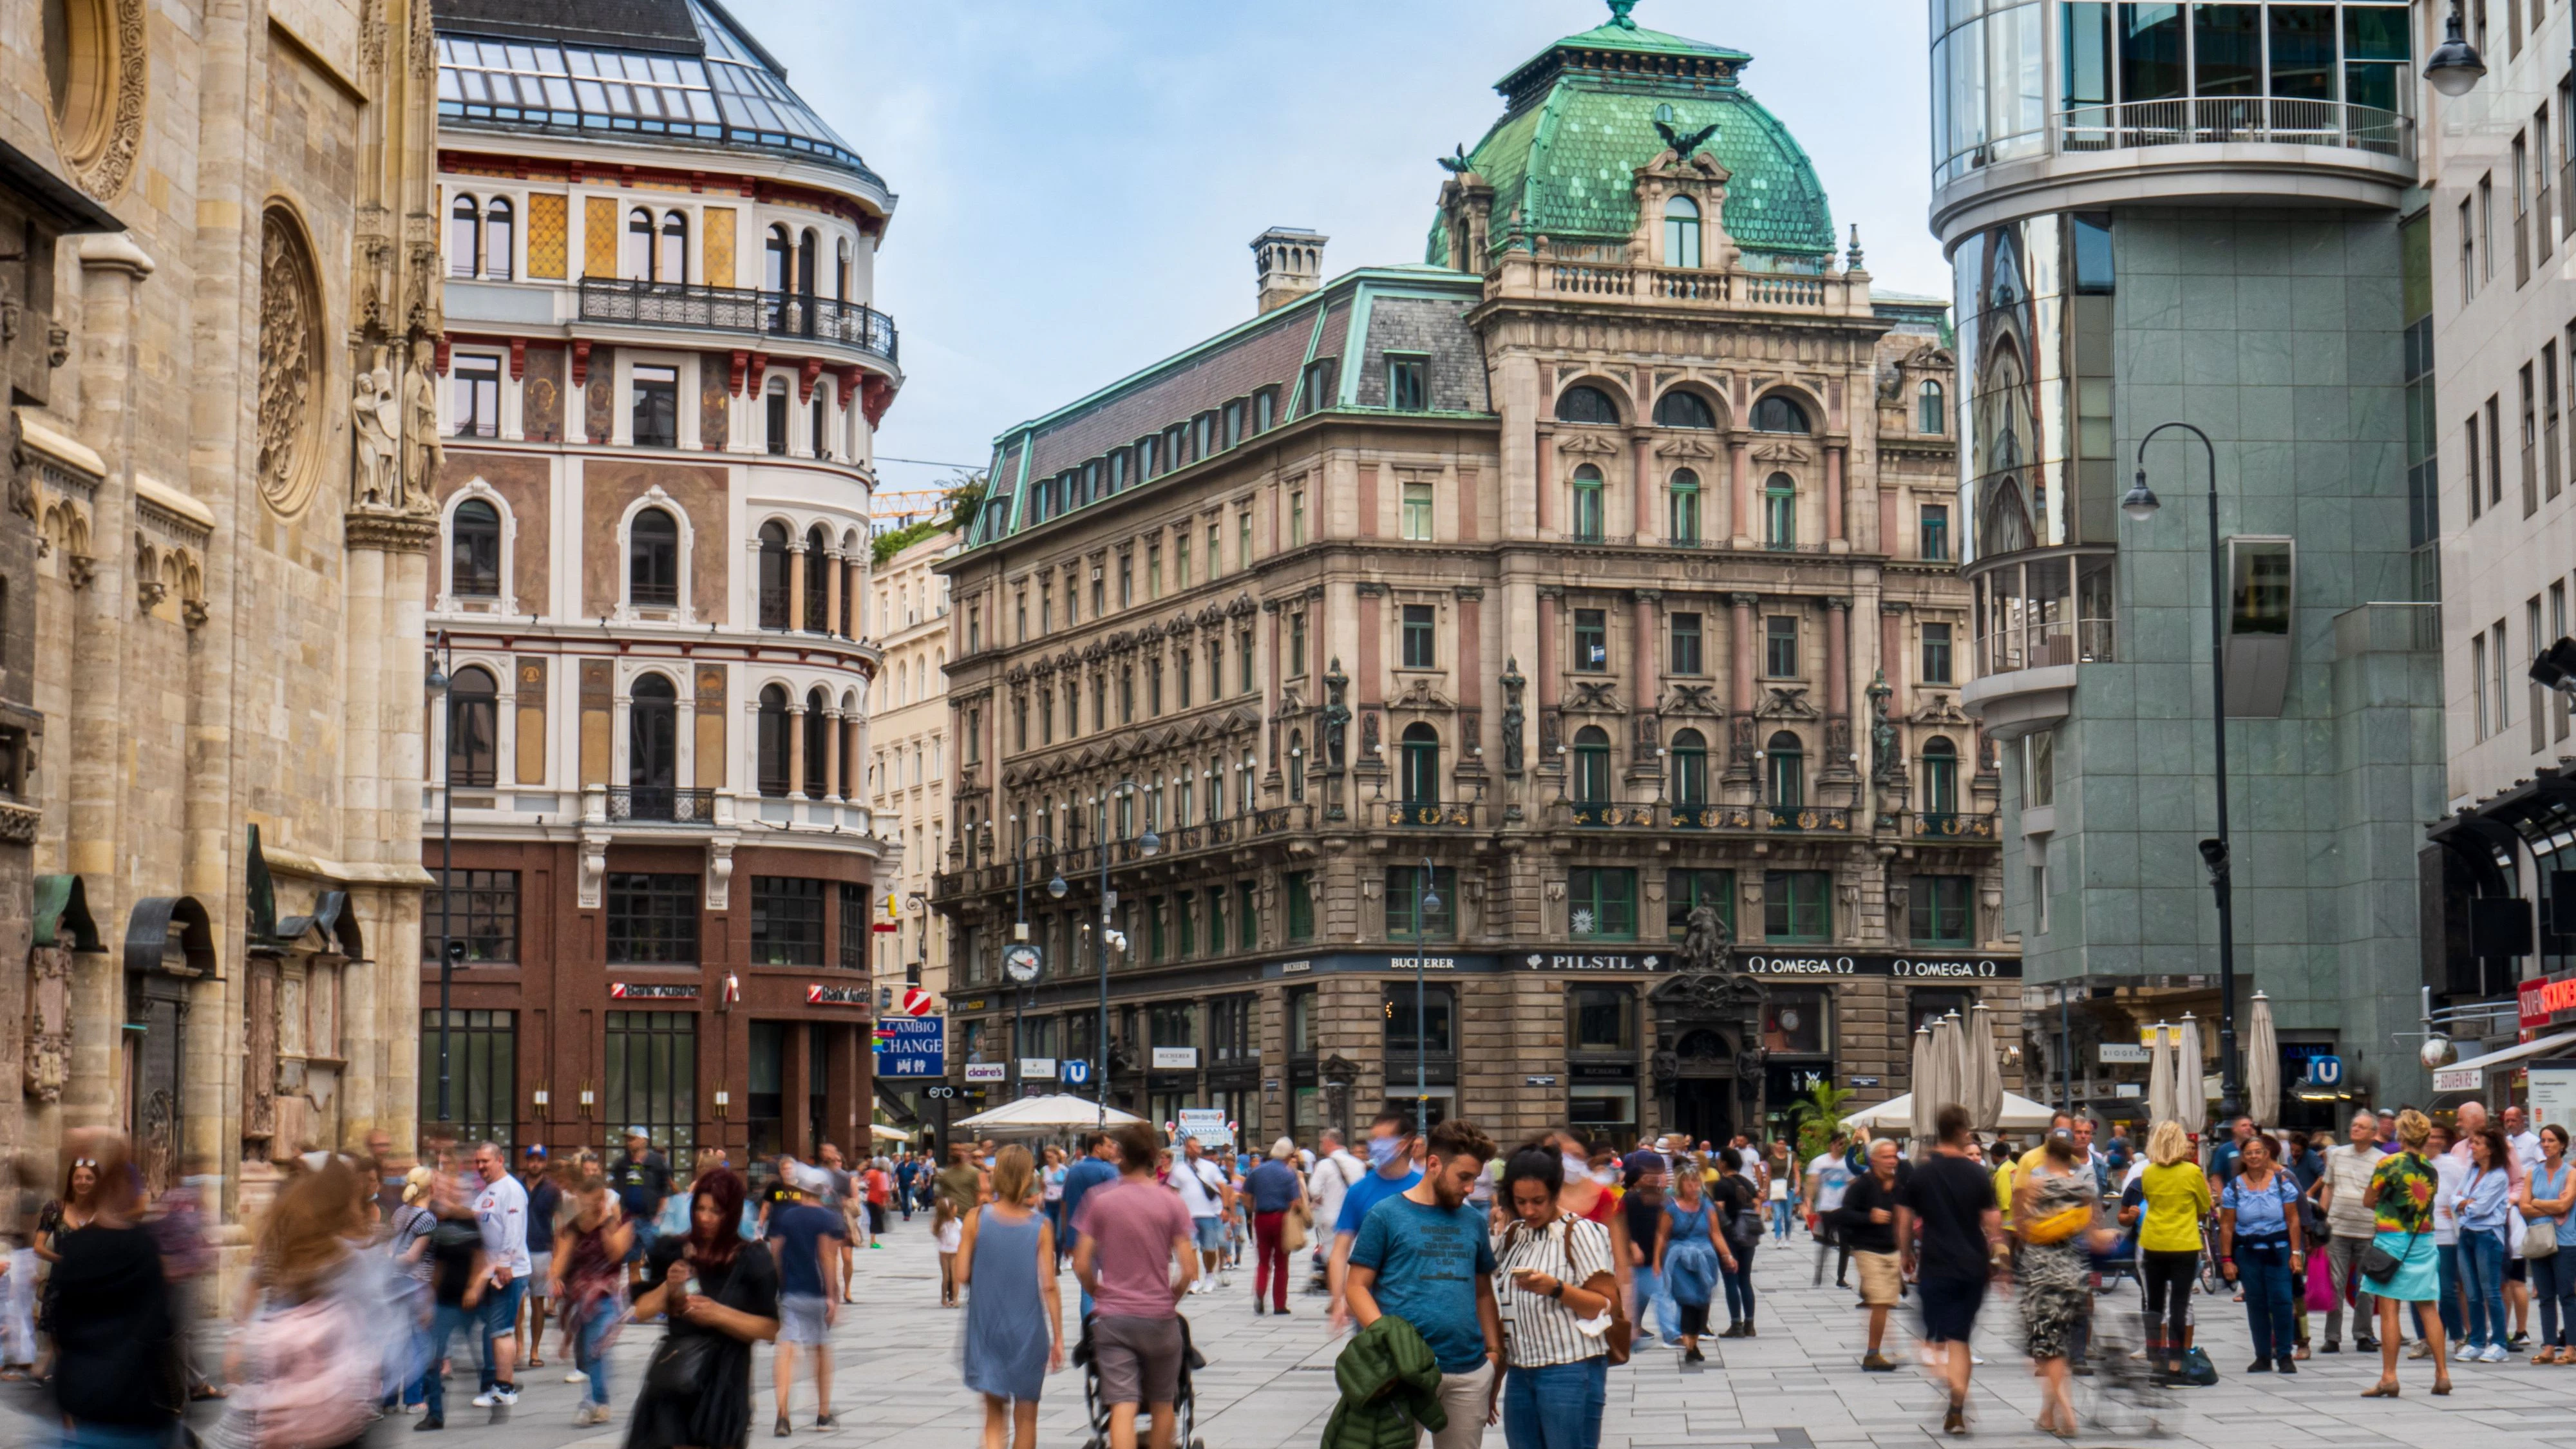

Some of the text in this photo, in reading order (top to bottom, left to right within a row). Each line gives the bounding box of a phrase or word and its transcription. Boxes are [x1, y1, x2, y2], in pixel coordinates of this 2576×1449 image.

[1553, 956, 1634, 969] PILSTL
[1771, 959, 1831, 974] OMEGA
[1915, 963, 1973, 977] OMEGA
[627, 984, 655, 996] Bank
[822, 985, 844, 1001] Bank
[887, 1021, 936, 1033] CAMBIO
[883, 1039, 943, 1053] CHANGE
[967, 1067, 1003, 1077] claire's
[1070, 1065, 1086, 1082] U
[2318, 1063, 2338, 1082] U
